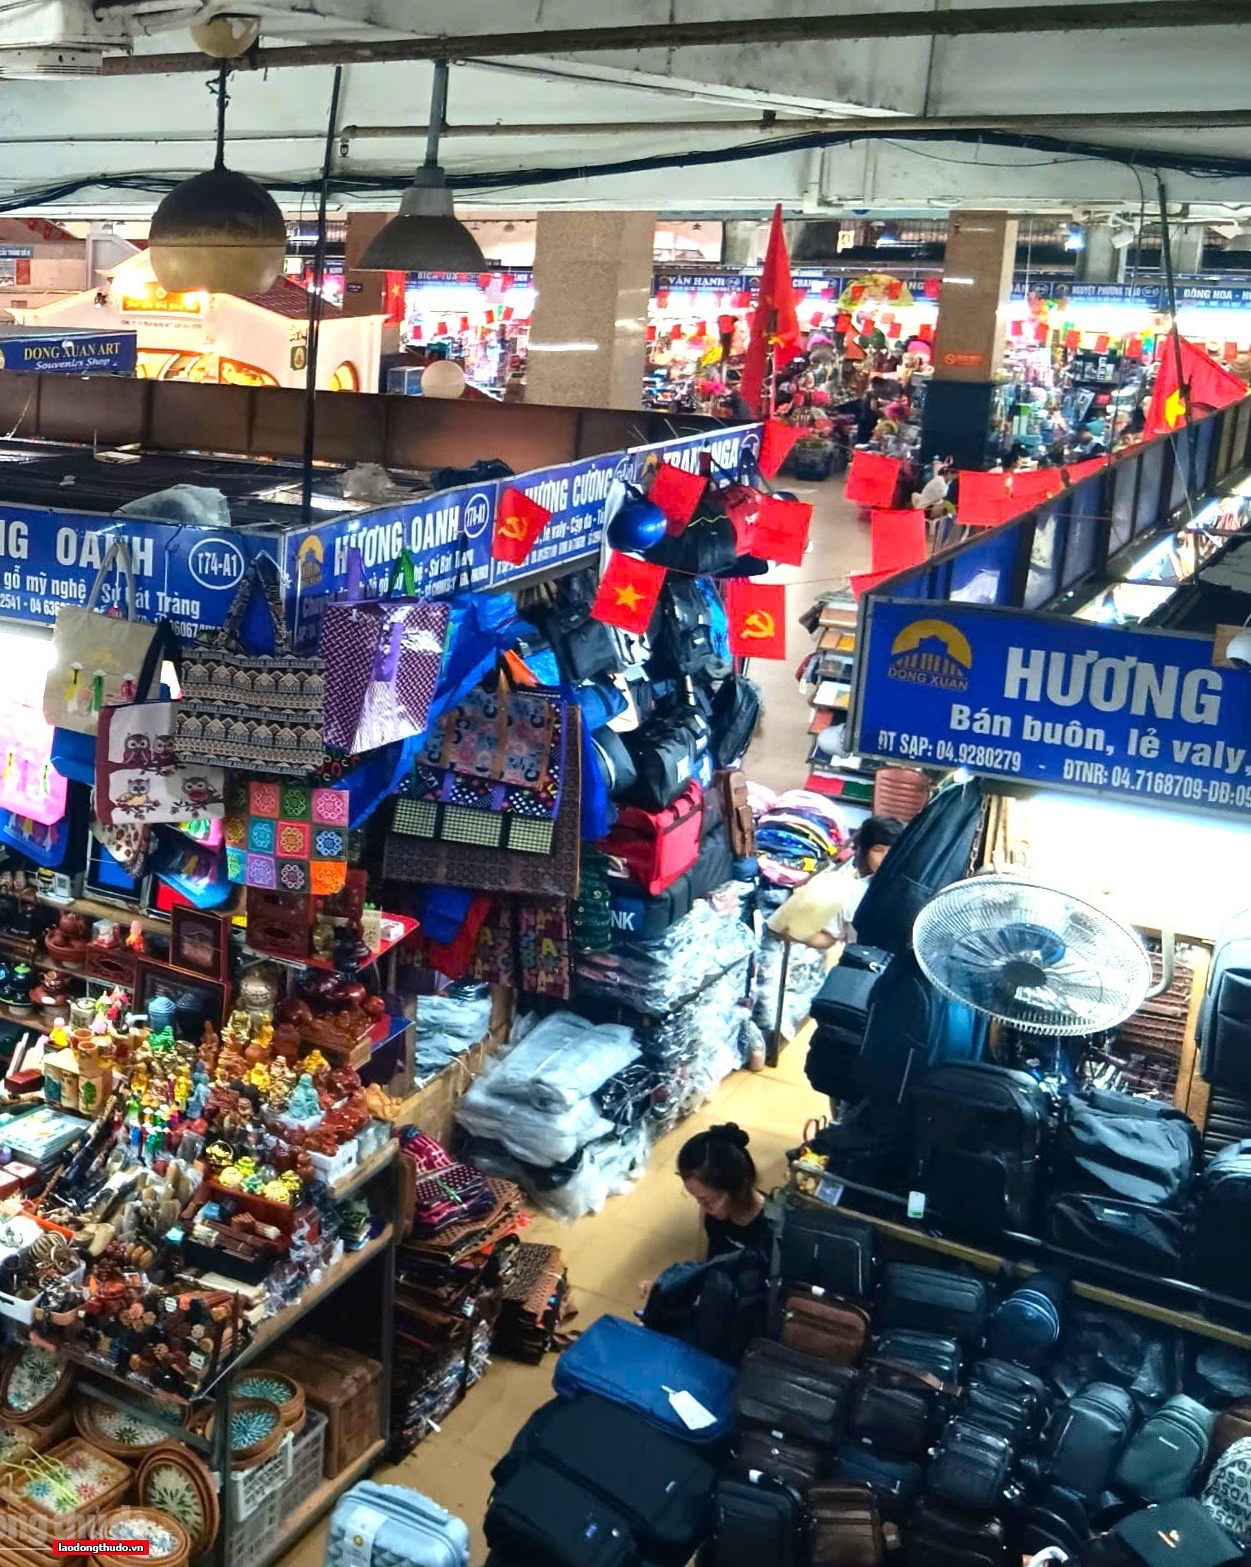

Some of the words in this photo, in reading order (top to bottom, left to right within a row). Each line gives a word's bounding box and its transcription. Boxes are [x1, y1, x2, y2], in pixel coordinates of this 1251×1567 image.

[96, 341, 121, 356] ART
[411, 504, 460, 554] OANH
[51, 578, 87, 604] nghệ
[1003, 646, 1224, 726] HƯƠNG
[950, 703, 1012, 738] Bán
[1022, 714, 1115, 756] buôn,
[1127, 728, 1161, 759] lẻ
[878, 730, 897, 751] ĐT
[899, 733, 933, 760] SẠP:
[936, 740, 1022, 773] 04.9280279
[1063, 758, 1109, 785] ĐTNR:
